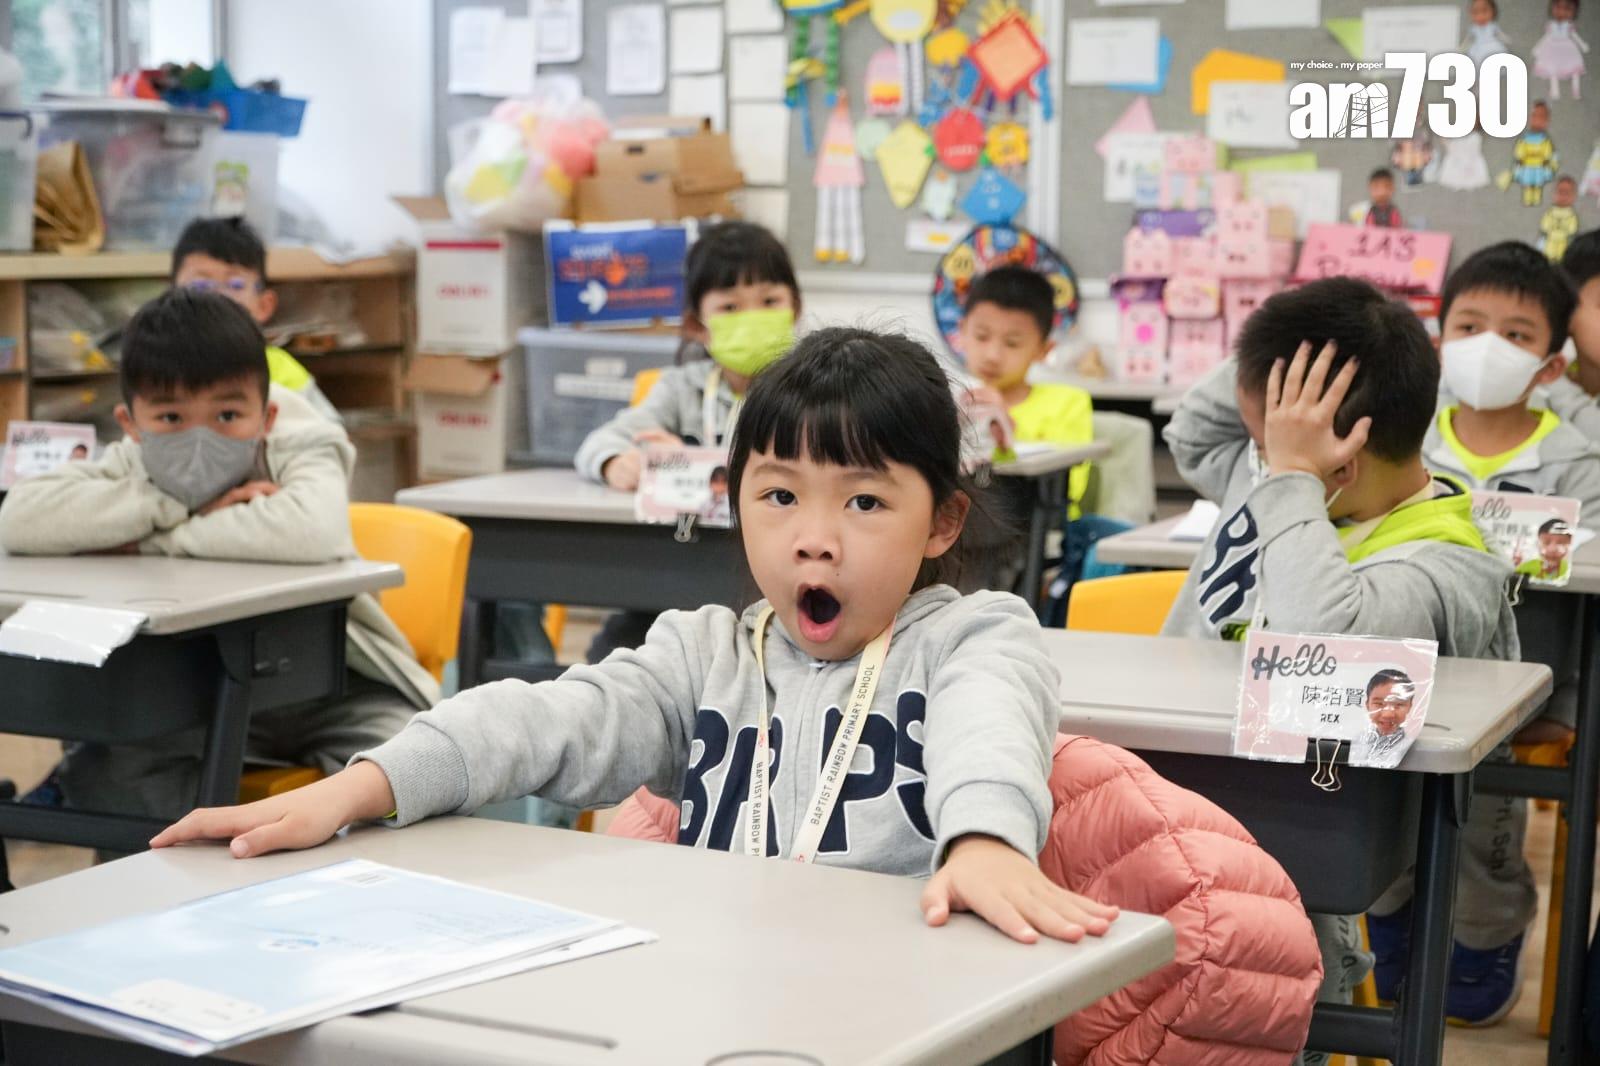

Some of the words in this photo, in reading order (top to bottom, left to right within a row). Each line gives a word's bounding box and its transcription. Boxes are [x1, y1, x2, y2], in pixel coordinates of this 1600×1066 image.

[1471, 497, 1513, 520] ello
[1251, 643, 1337, 681] Hello
[1320, 713, 1340, 723] REX
[810, 785, 833, 825] BAPTIST
[826, 742, 849, 784] RAINBOW
[842, 702, 863, 741] PRIMARY
[857, 664, 876, 700] SCHOOL
[751, 802, 762, 844] RAINBOW
